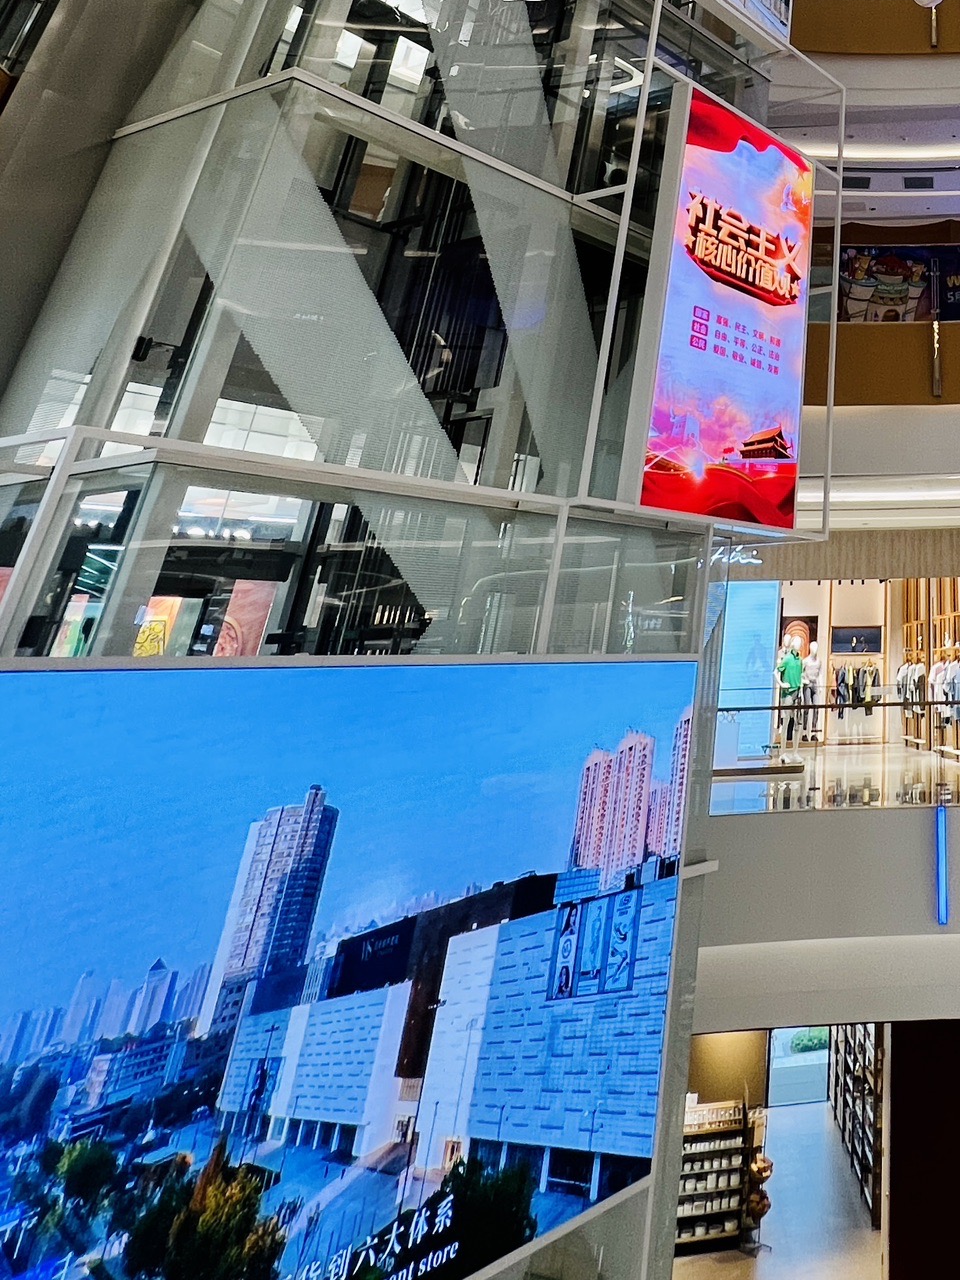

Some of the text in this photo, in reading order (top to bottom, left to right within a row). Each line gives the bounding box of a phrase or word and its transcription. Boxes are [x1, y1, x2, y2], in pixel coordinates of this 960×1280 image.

[686, 191, 802, 277] 社会主义
[694, 231, 792, 299] 核心价值观
[417, 1240, 460, 1277] store
